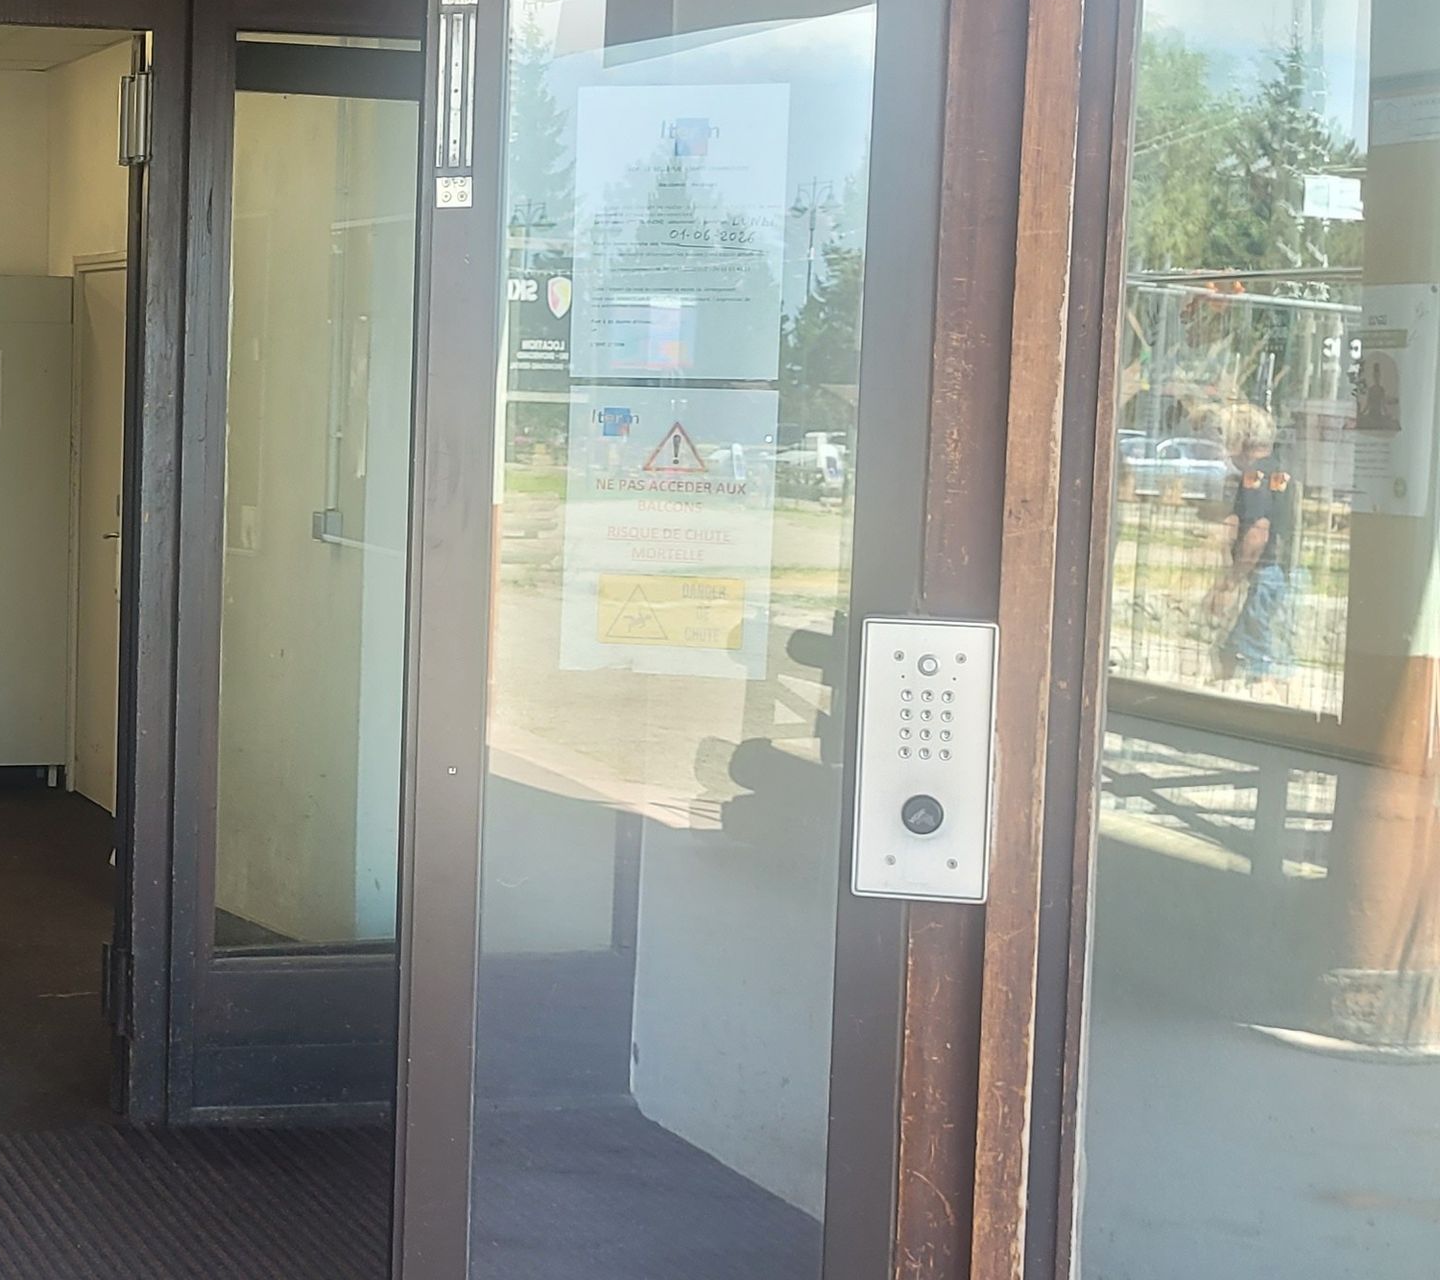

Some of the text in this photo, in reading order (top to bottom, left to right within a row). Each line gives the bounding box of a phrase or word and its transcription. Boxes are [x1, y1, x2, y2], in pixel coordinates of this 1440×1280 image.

[596, 478, 747, 496] NE PAS ACCEDER AUX
[638, 499, 704, 514] BALCONS
[607, 525, 732, 543] RISQUE DE CHUTE
[631, 546, 705, 561] MORTELLE
[684, 626, 720, 643] CHUTE
